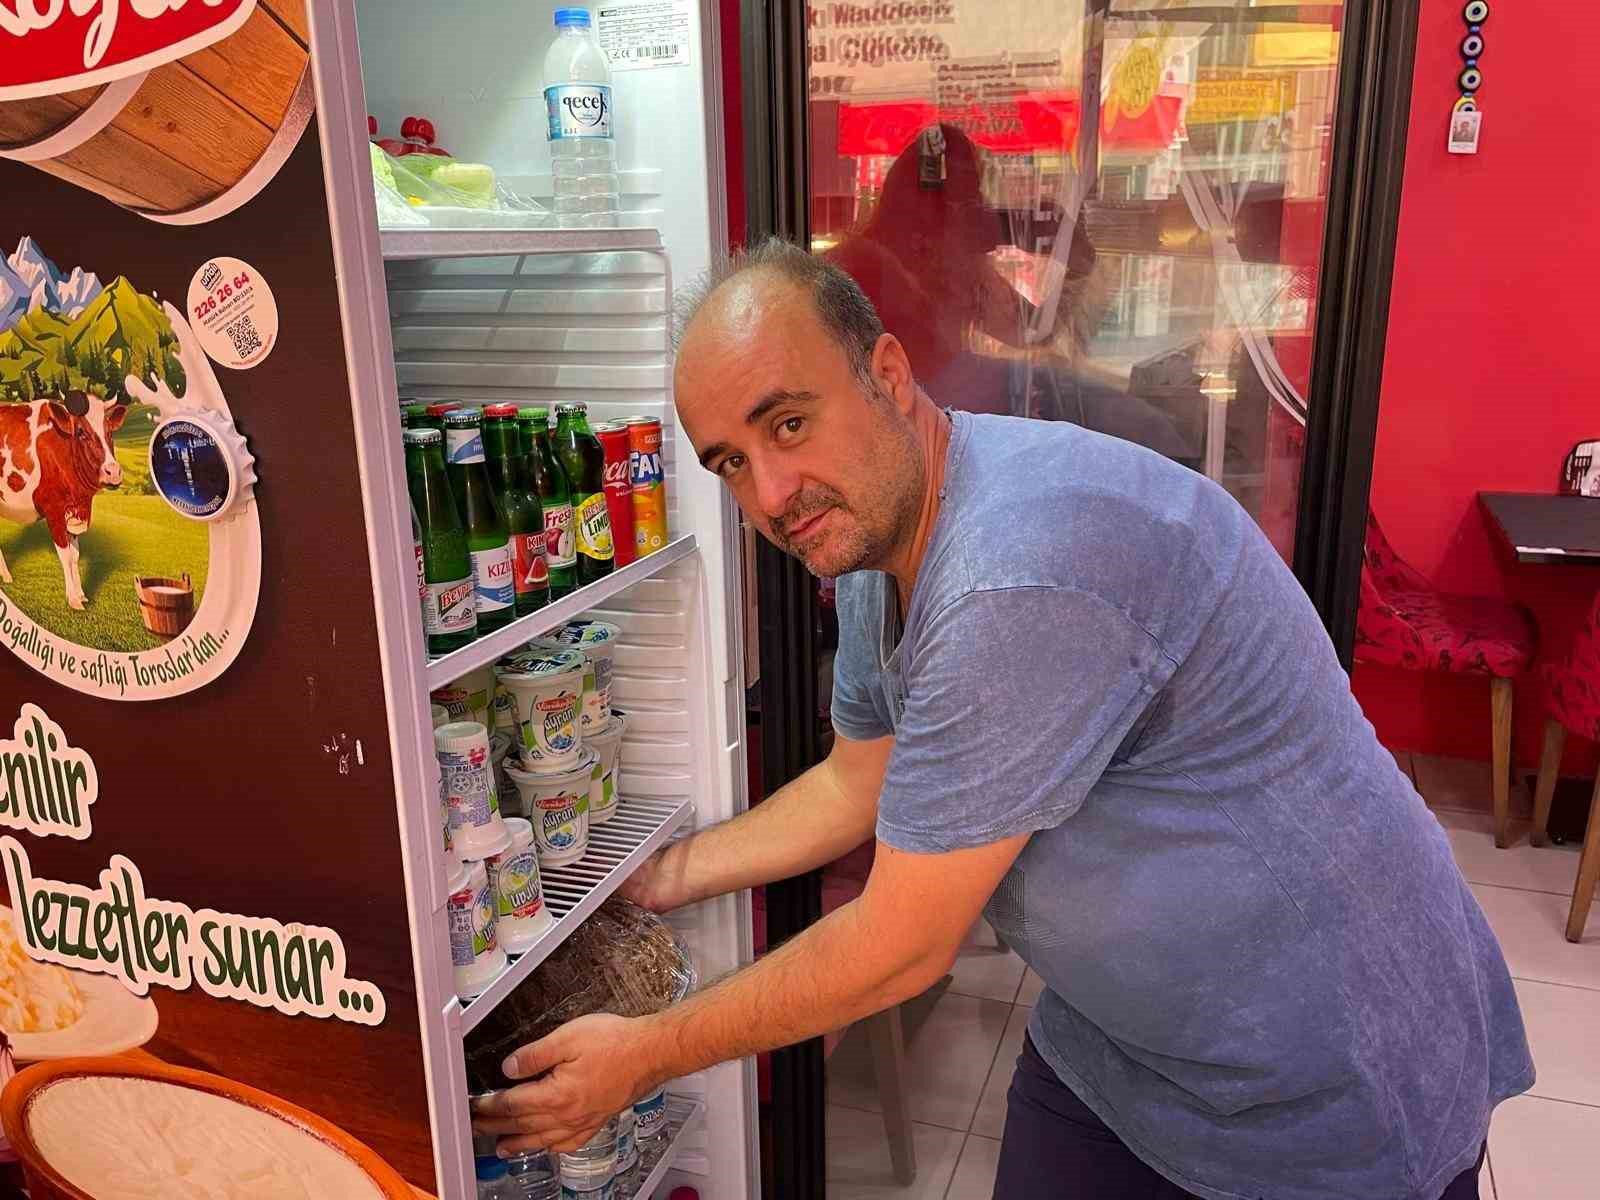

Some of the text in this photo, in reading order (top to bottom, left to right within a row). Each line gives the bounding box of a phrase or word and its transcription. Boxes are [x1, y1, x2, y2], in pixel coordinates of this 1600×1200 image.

[194, 296, 217, 319] 226
[217, 284, 233, 303] 26
[233, 271, 250, 289] 64
[59, 651, 76, 674] ve
[81, 653, 129, 697] saflığı
[129, 630, 230, 687] Toroslar'dan...
[544, 708, 575, 733] ayran
[544, 807, 576, 829] ayran
[9, 847, 190, 984] lezzetler
